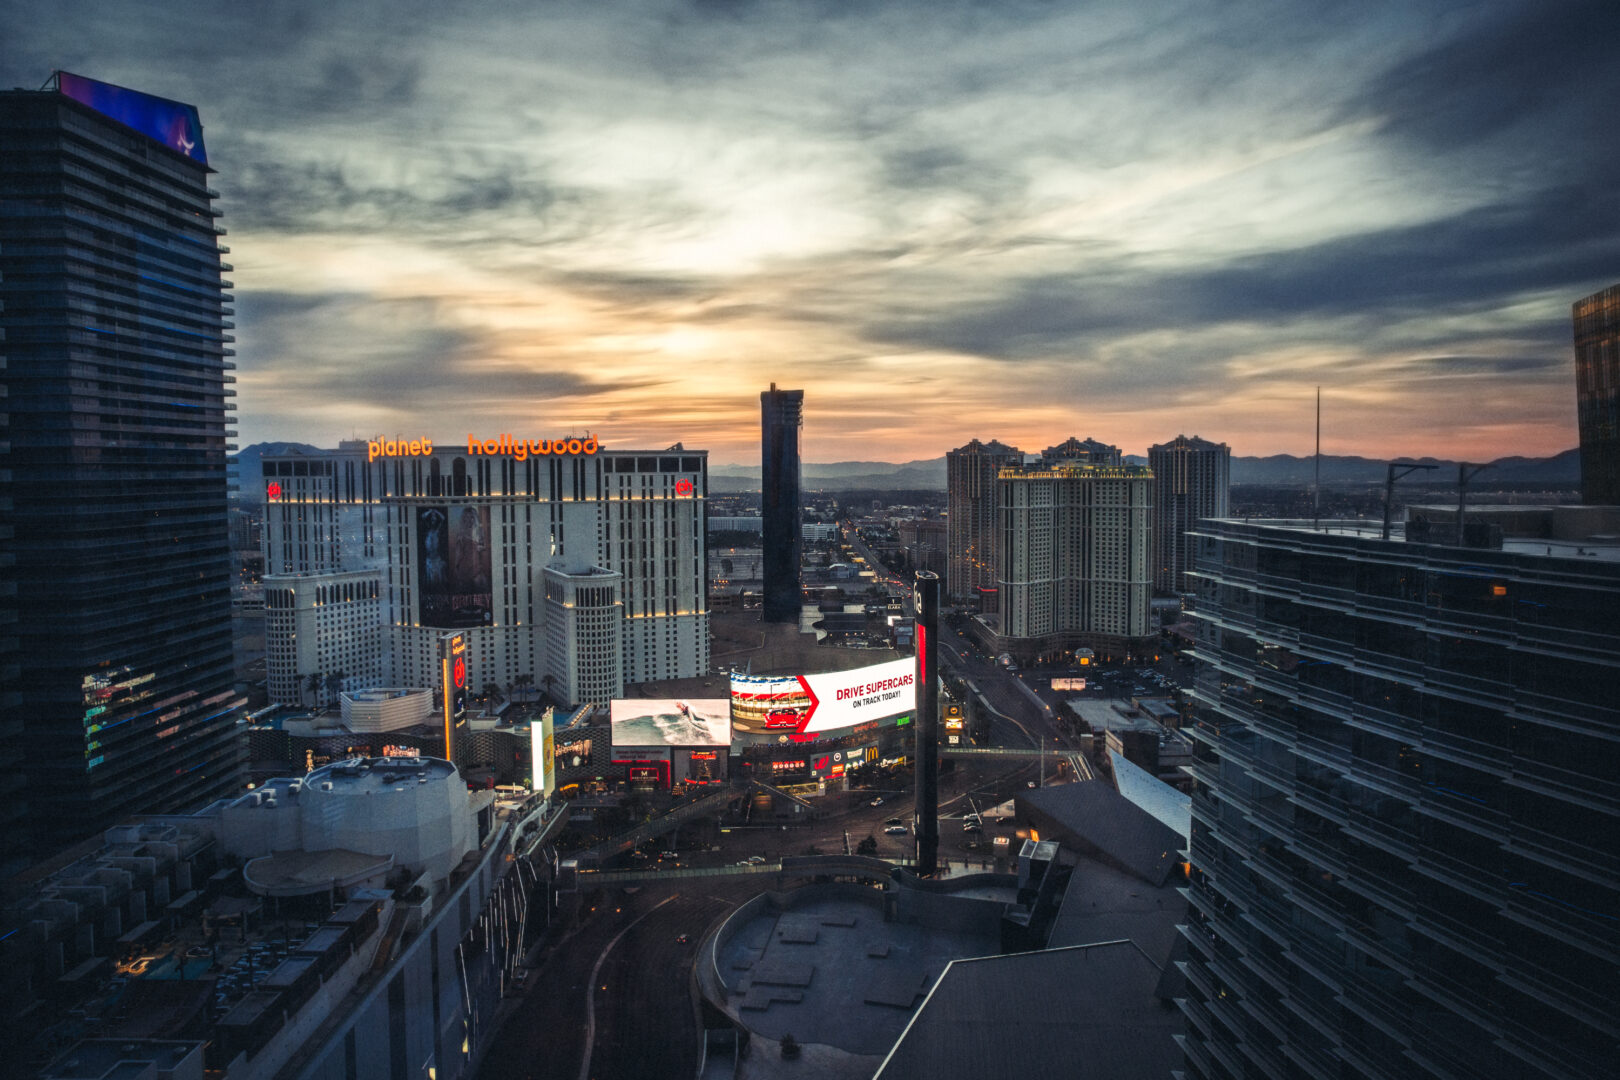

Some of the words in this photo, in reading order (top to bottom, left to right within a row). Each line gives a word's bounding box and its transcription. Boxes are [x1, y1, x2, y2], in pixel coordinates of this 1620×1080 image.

[368, 435, 432, 462] planet
[468, 433, 598, 461] hollywood
[836, 685, 864, 701] DRIVE
[866, 674, 914, 694] SUPERCARS
[852, 700, 861, 708] ON
[862, 695, 881, 706] TRACK
[881, 690, 901, 701] TODAY!
